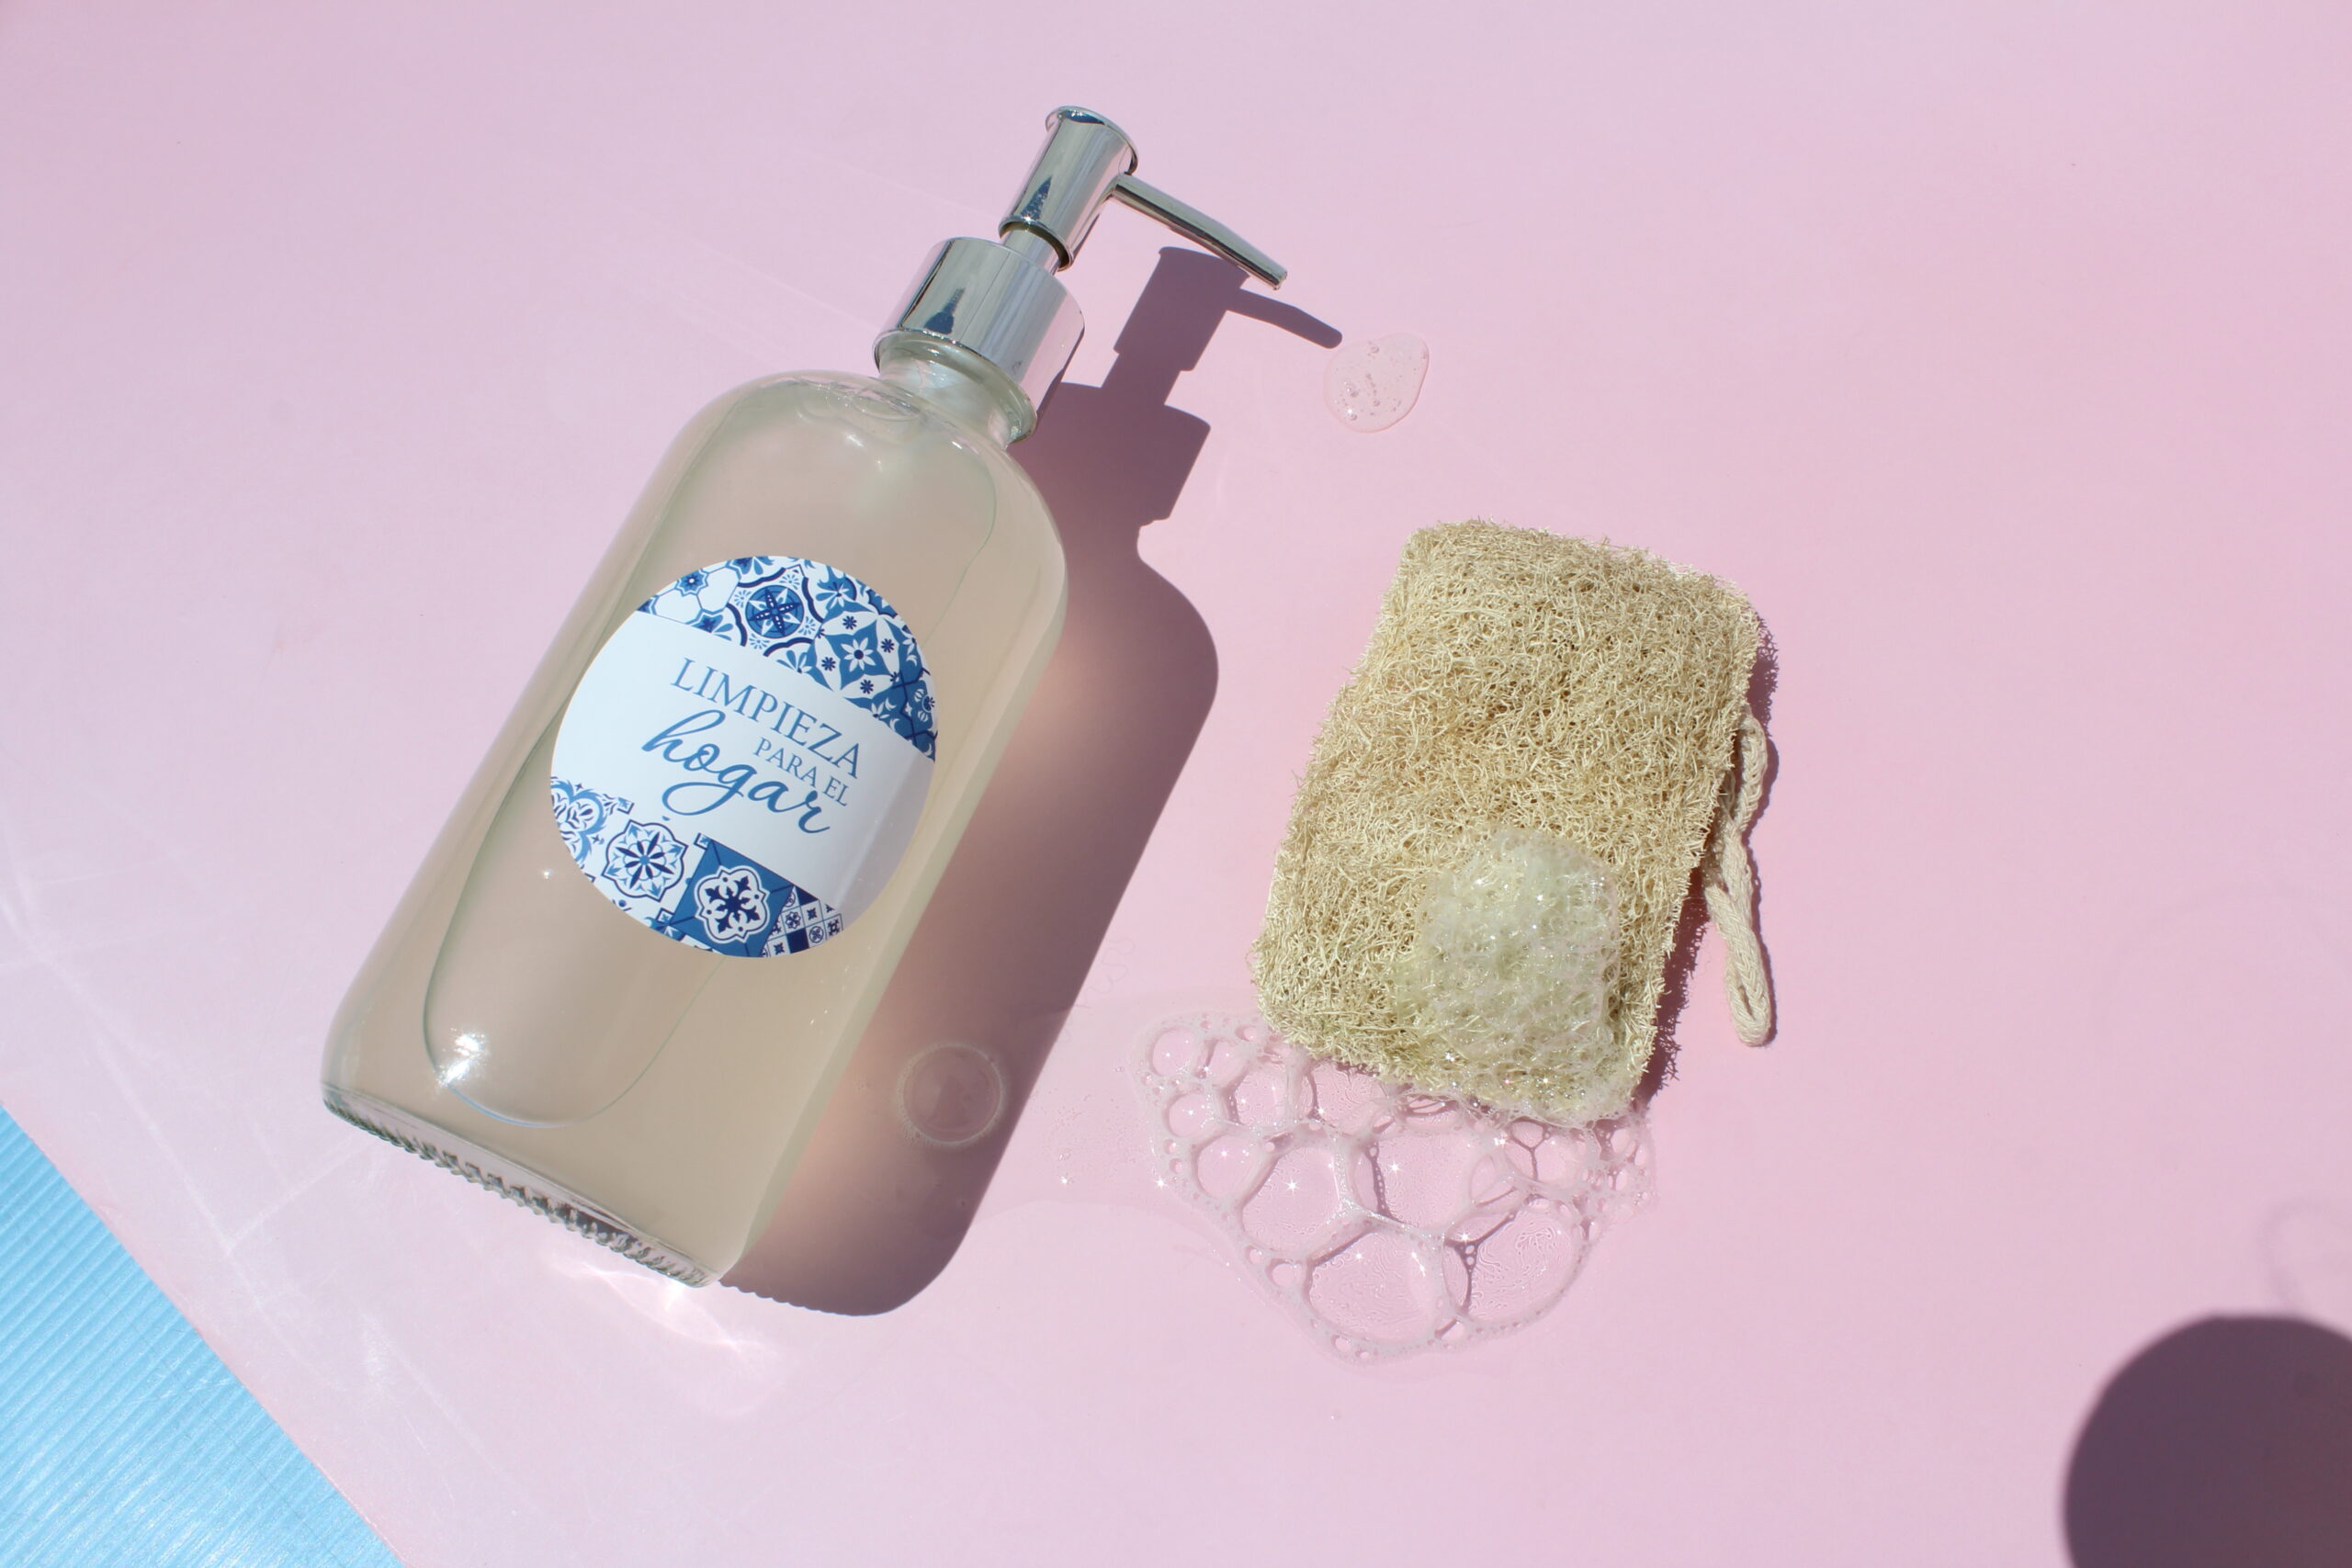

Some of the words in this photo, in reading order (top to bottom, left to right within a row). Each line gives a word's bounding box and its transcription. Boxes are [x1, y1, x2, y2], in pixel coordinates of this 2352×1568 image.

[641, 709, 831, 834] hogar
[671, 657, 860, 779] LIMPIEZA
[752, 737, 819, 787] PARA
[823, 776, 850, 807] EL
